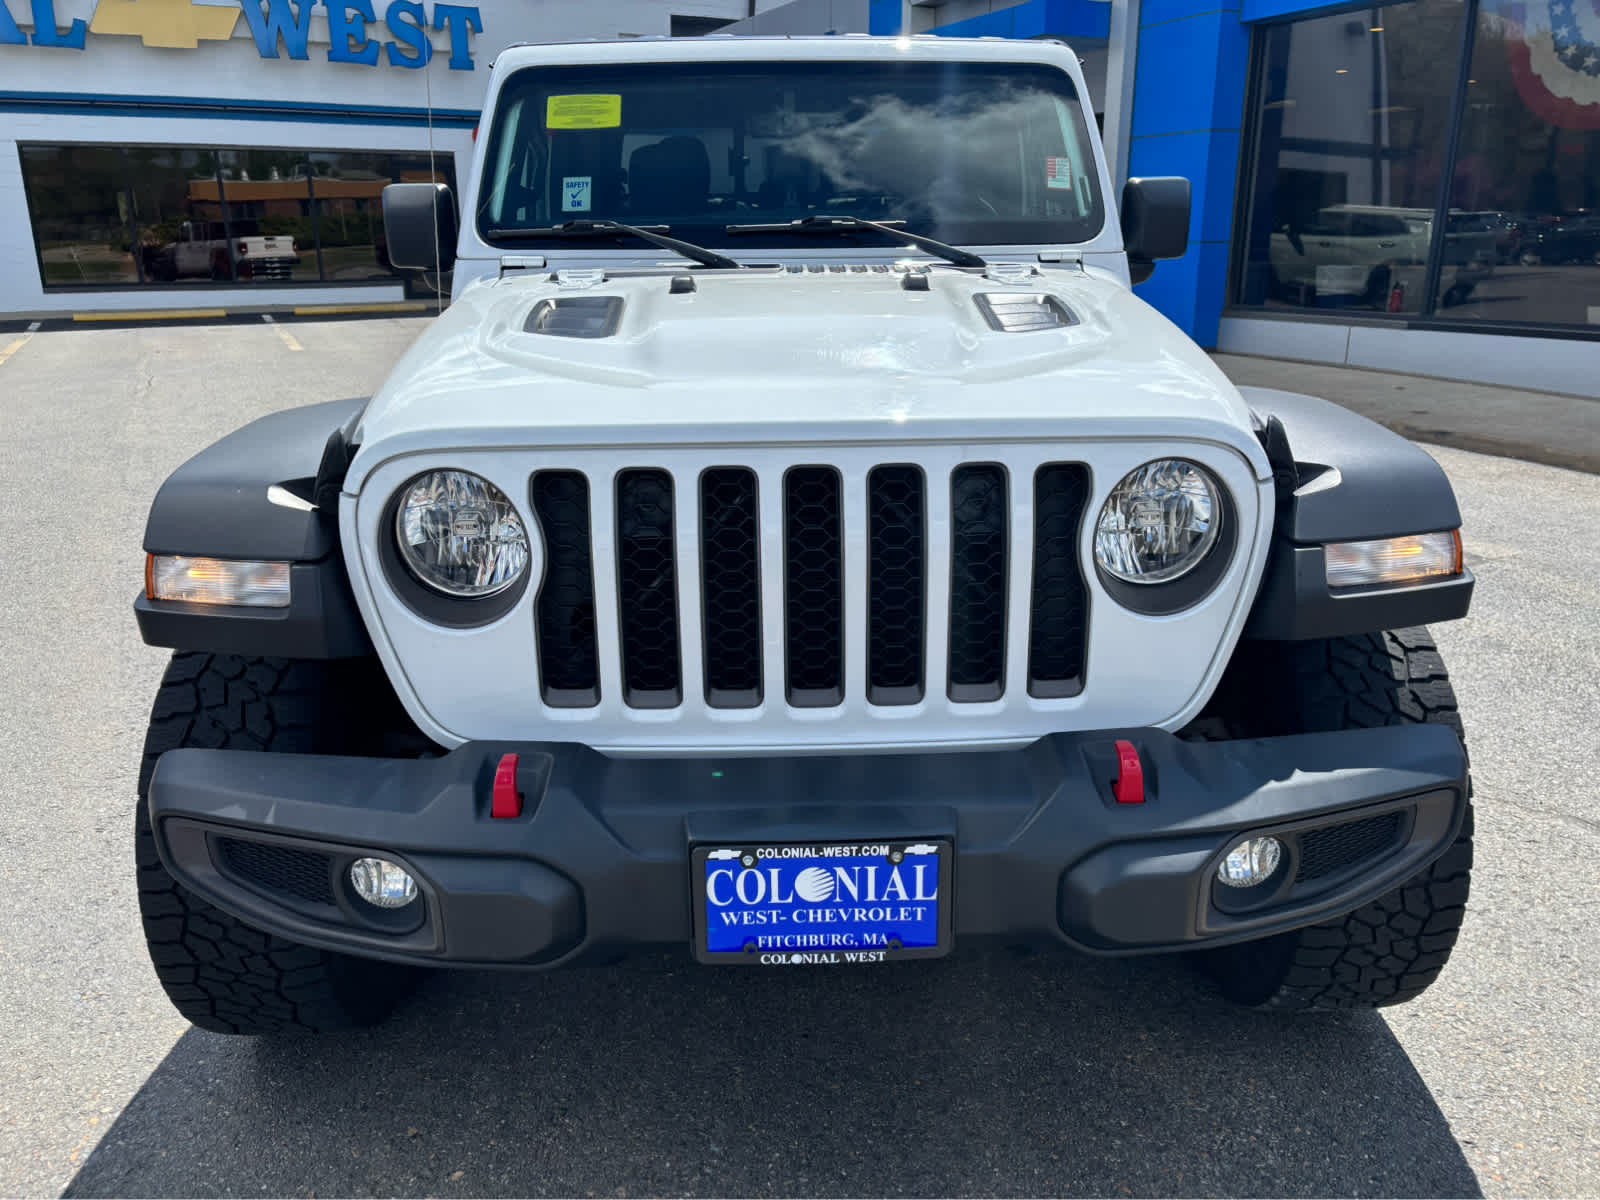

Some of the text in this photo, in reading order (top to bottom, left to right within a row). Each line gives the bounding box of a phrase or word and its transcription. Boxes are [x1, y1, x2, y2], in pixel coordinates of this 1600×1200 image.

[239, 0, 483, 71] WEST
[565, 181, 590, 189] SAFETY
[570, 200, 583, 208] OK
[756, 845, 890, 859] COLONIAL-WEST.COM
[706, 864, 938, 906] COLONIAL
[792, 907, 927, 924] CHEVROLET
[758, 932, 888, 949] FITCHBURG, MA
[760, 951, 886, 965] COLONIAL WEST
